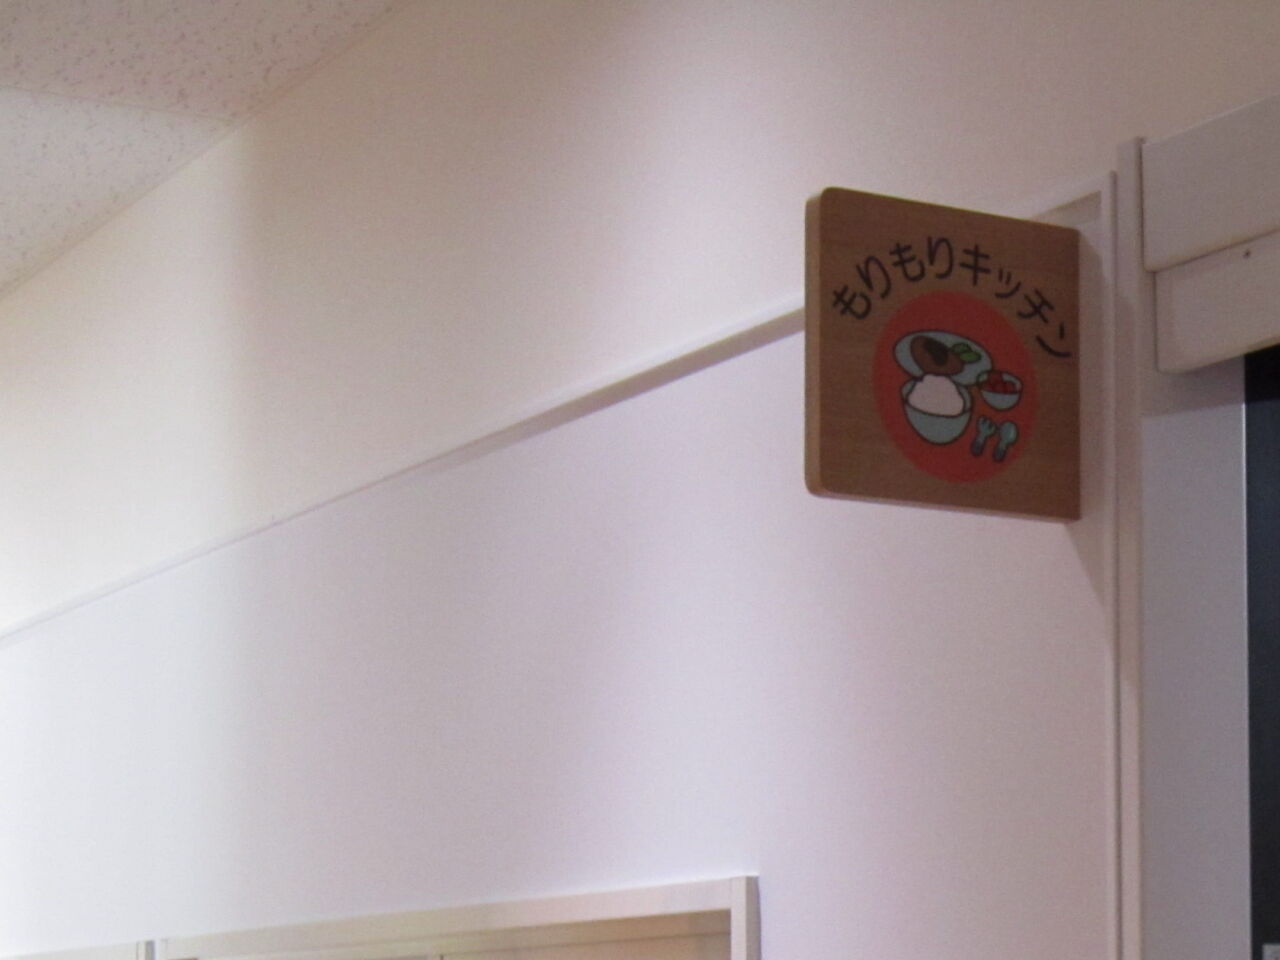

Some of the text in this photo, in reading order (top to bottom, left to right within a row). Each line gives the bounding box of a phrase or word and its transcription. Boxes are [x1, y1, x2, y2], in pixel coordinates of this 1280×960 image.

[832, 236, 1072, 358] もりもりキッチン
